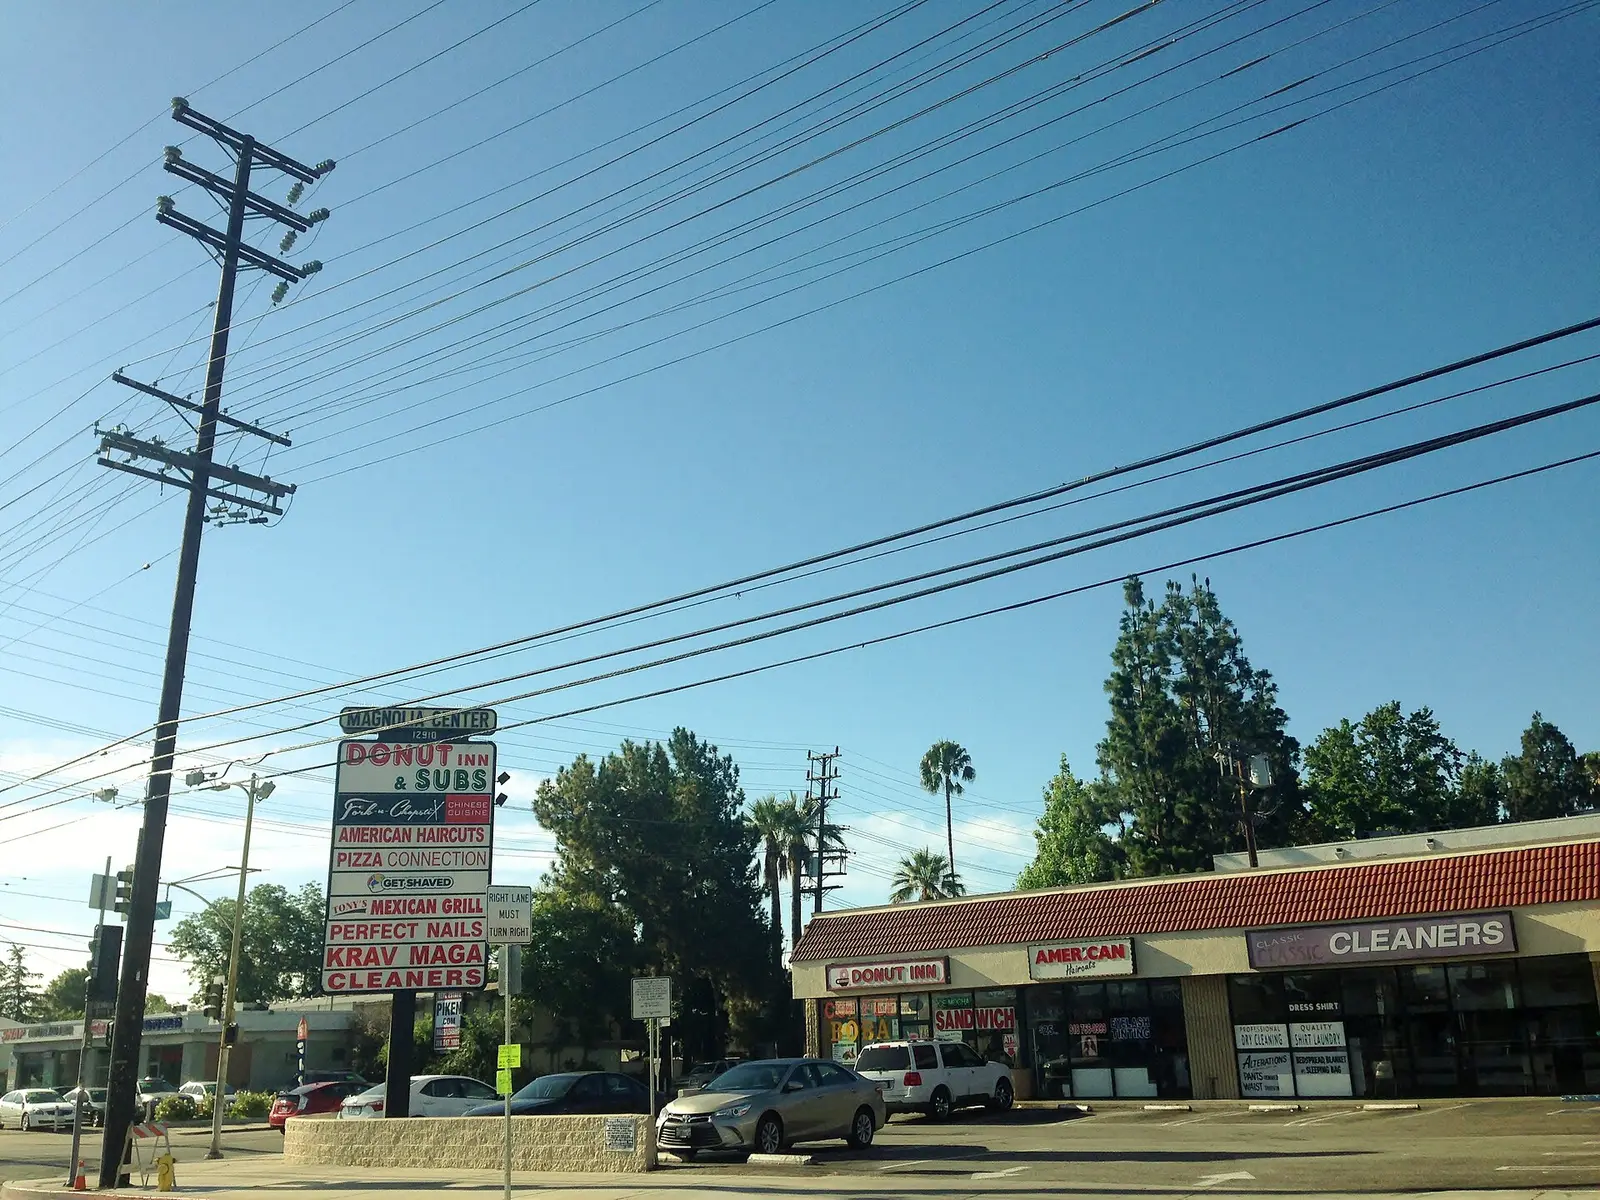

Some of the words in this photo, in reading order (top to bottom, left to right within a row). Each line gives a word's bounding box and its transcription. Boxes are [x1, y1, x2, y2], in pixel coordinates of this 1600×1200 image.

[346, 710, 425, 728] MAGNOLIA
[432, 710, 489, 728] CENTER
[412, 731, 437, 740] 12910
[345, 743, 454, 767] DONUT
[457, 753, 489, 767] INN
[394, 776, 407, 790] &
[415, 769, 487, 791] SUBS
[448, 801, 488, 809] CHINESE
[338, 827, 412, 843] AMERICAN
[416, 827, 485, 843] HAIRCUTS
[337, 852, 383, 867] PIZZA
[387, 851, 487, 867] CONNECTION
[489, 893, 508, 903] RIGHT
[511, 893, 529, 903] LANE
[332, 899, 368, 914] TONY'S
[370, 899, 437, 915] MEXICAN
[441, 898, 483, 914] GRILL
[499, 909, 520, 919] MUST
[329, 922, 419, 940] PERFECT
[426, 921, 483, 939] NAILS
[489, 927, 507, 937] TURN
[509, 927, 529, 937] RIGHT
[1256, 932, 1305, 949] CLASSIC
[1328, 920, 1505, 955] CLEANERS
[326, 946, 398, 967] KRAV
[409, 944, 483, 965] MAGA
[327, 969, 482, 990] CLEANERS
[851, 965, 905, 984] DONUT
[909, 963, 937, 980] INN
[1288, 1003, 1314, 1012] DRESS
[1316, 1002, 1339, 1011] SHIRT
[935, 1008, 1016, 1030] SANDWICH
[1110, 1016, 1150, 1029] EYELASH
[830, 1019, 890, 1042] BOBA
[1111, 1027, 1151, 1040] TINTING
[1239, 1025, 1281, 1033] PROFESSIONAL
[1300, 1023, 1333, 1032] QUALITY
[1241, 1034, 1252, 1046] DRY
[1253, 1033, 1283, 1046] CLEANING
[1295, 1033, 1312, 1046] SHIRT
[1313, 1033, 1341, 1046] LAUNDRY
[1242, 1054, 1287, 1070] ALTERATIONS
[1243, 1072, 1264, 1081] PANTS
[1243, 1082, 1263, 1091] WAIST
